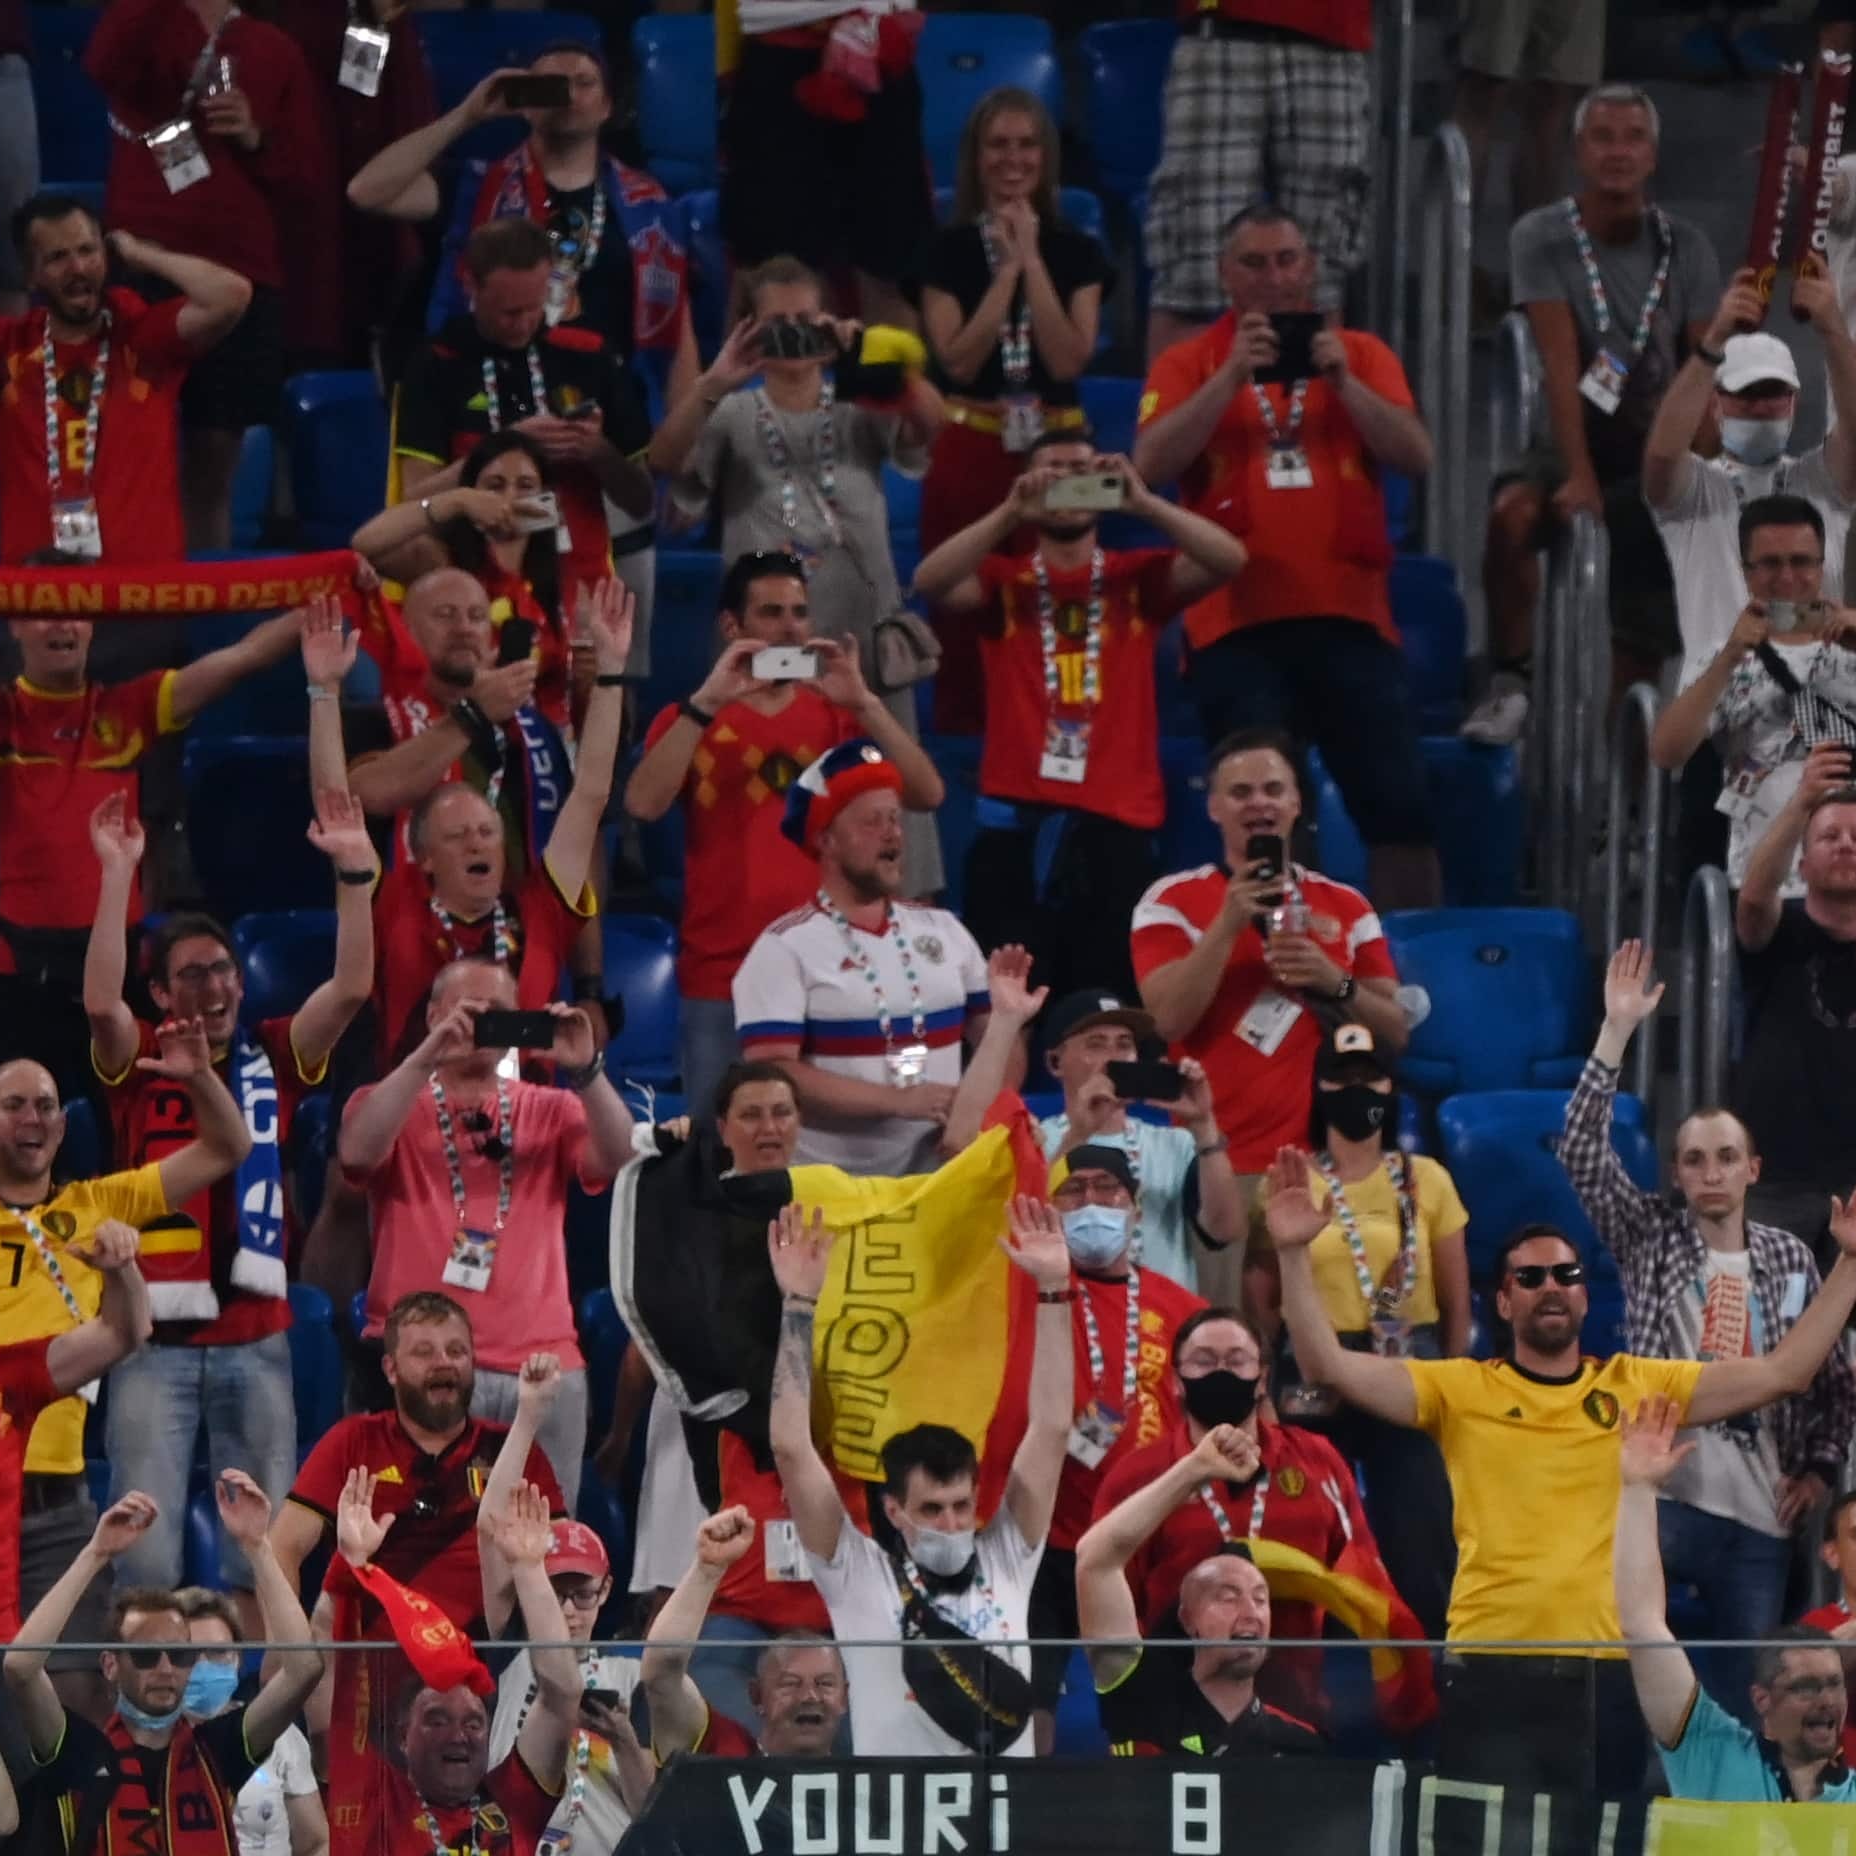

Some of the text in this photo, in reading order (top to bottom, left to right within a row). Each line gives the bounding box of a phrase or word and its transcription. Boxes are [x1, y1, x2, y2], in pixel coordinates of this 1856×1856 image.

[117, 582, 216, 613] RED
[0, 1241, 25, 1287] 7
[1172, 1772, 1222, 1856] 8
